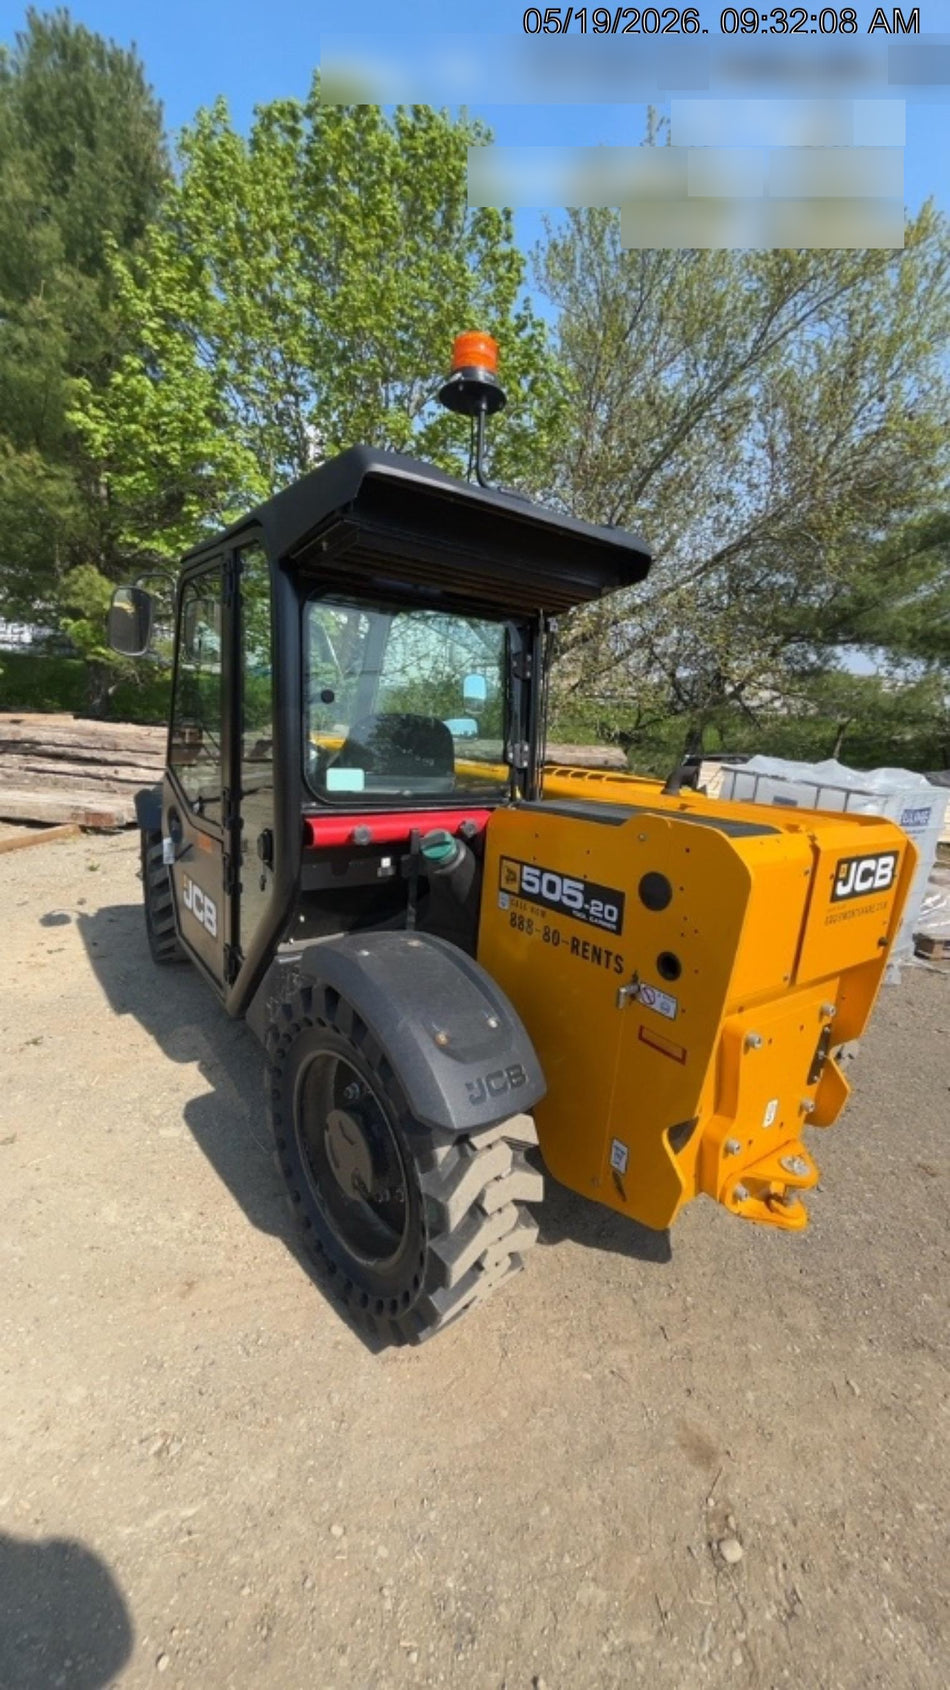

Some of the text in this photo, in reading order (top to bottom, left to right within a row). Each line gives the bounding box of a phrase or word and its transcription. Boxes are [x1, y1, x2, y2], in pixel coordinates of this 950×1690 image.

[836, 856, 894, 896] JCB
[183, 878, 217, 938] JCB
[509, 911, 624, 974] 888-80-RENTS
[465, 1064, 528, 1106] JCB
